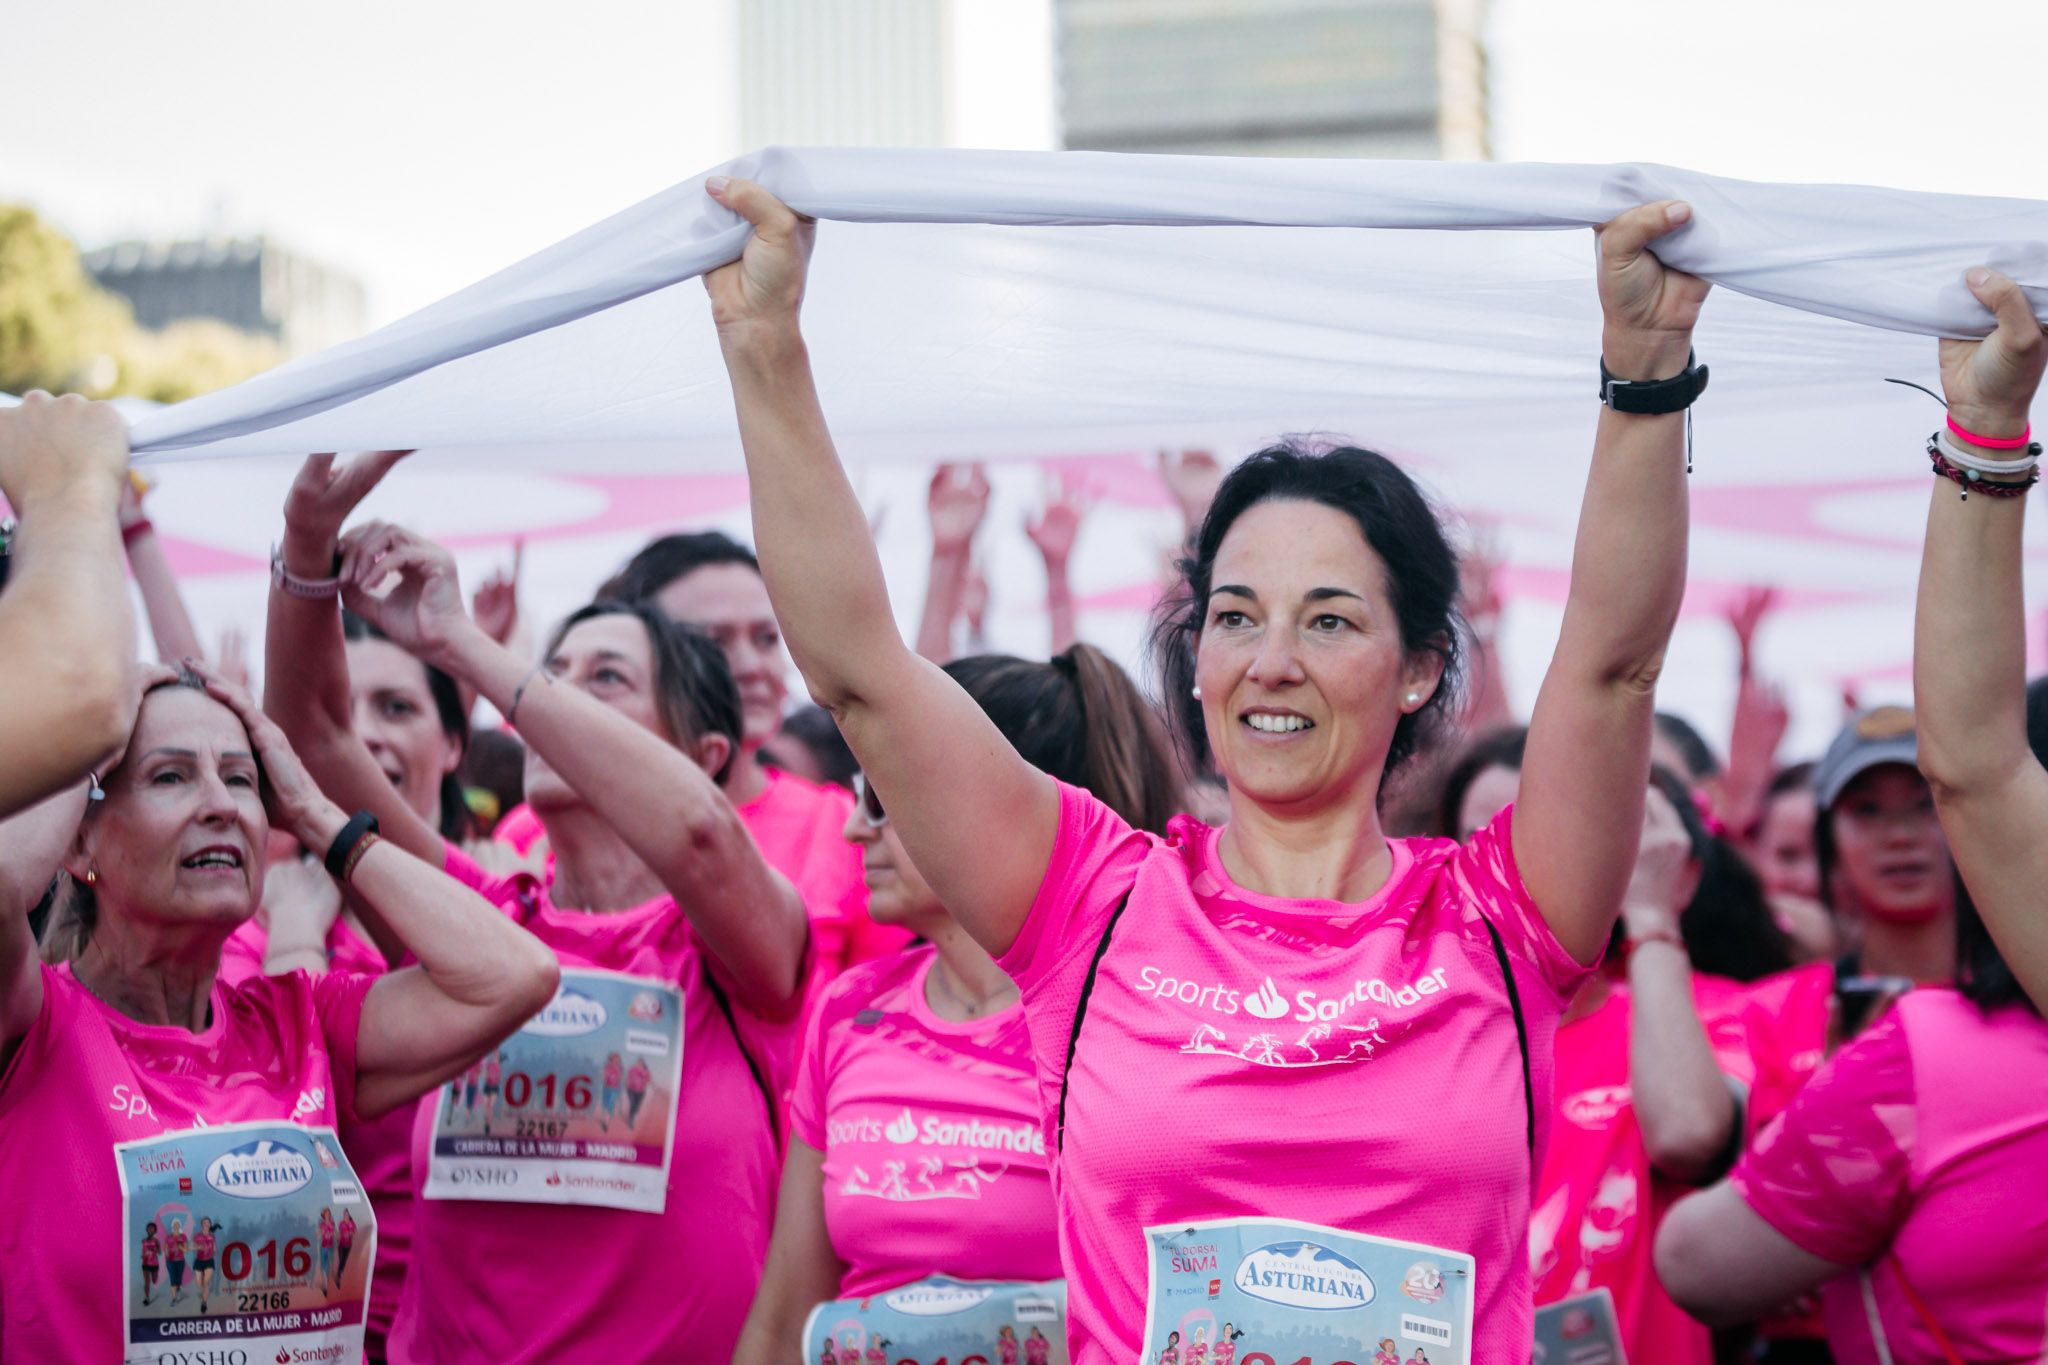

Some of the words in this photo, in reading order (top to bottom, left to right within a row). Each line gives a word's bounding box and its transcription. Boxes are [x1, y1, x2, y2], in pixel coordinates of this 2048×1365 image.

[1135, 966, 1239, 1014] Sports
[504, 1071, 592, 1110] 016
[516, 1120, 568, 1137] 22167
[919, 1116, 1046, 1156] Santande
[522, 1141, 536, 1155] LA
[586, 1143, 638, 1161] MADRID
[451, 1167, 518, 1184] OYSHO
[565, 1174, 636, 1192] Santander
[221, 1237, 312, 1281] 016
[1183, 1244, 1219, 1256] DORSAL
[1171, 1256, 1218, 1273] SUMA
[1242, 1261, 1366, 1301] ASTURIANA
[238, 1291, 290, 1312] 22166
[159, 1320, 222, 1336] CARRERA
[226, 1318, 244, 1333] DE
[247, 1317, 261, 1332] LA
[263, 1313, 301, 1331] MUJER
